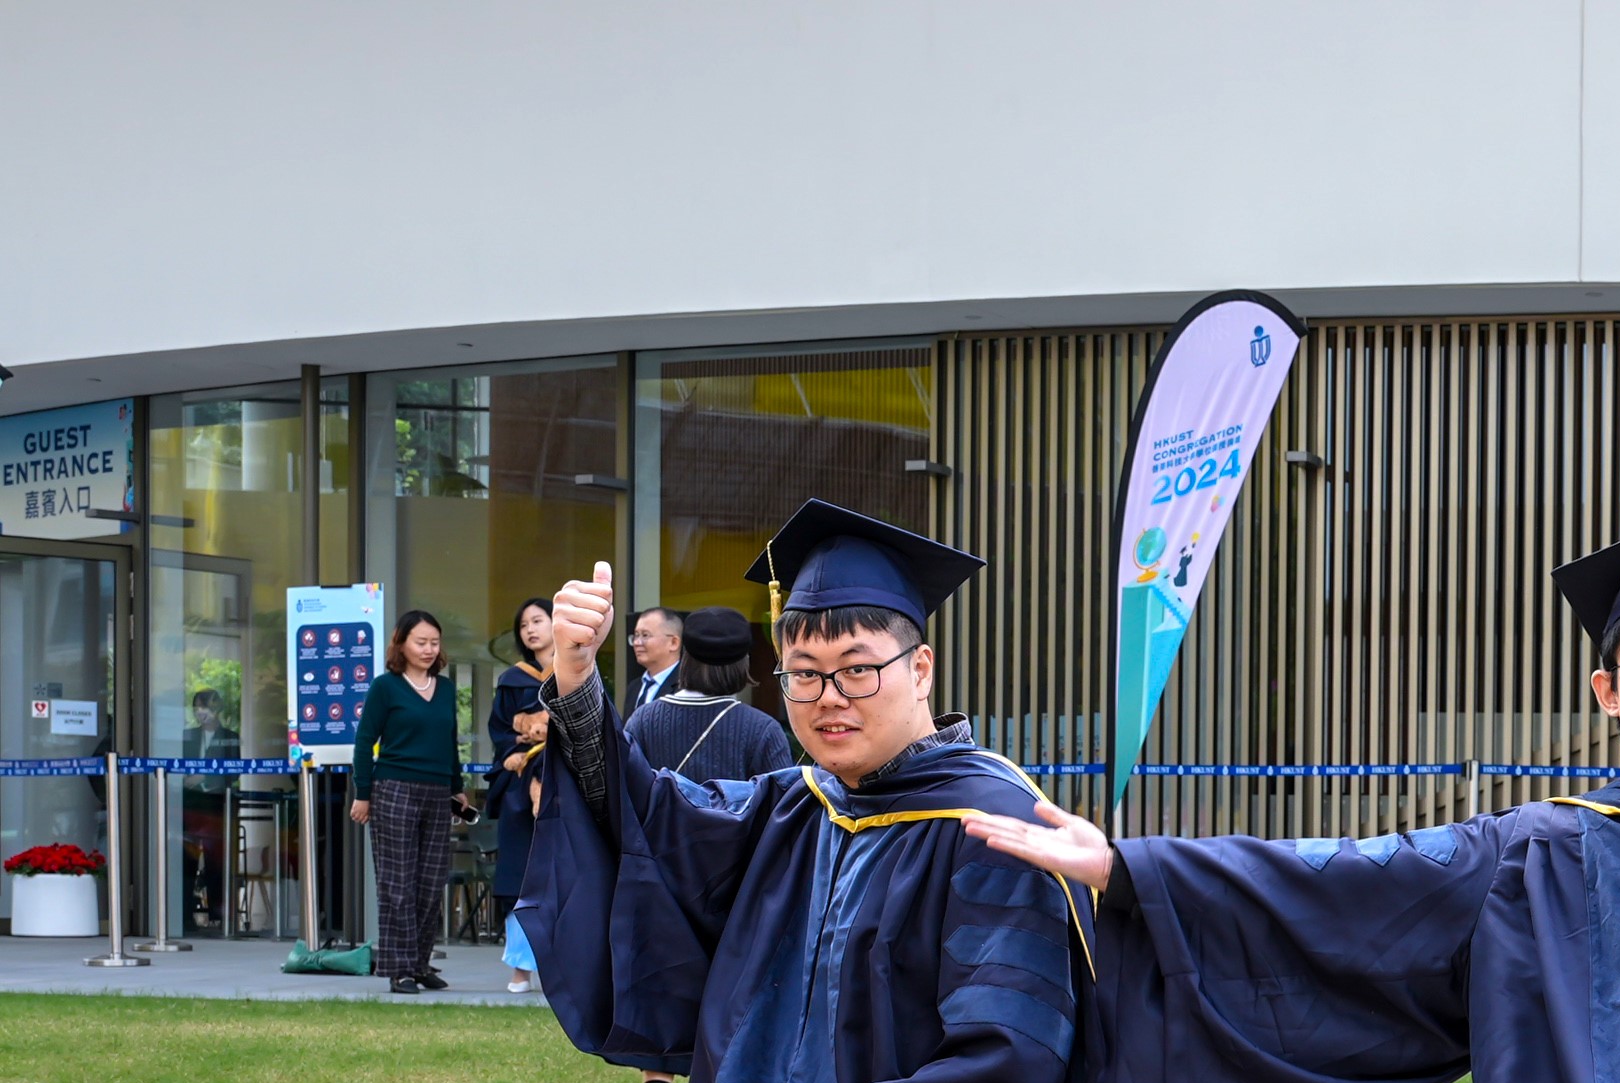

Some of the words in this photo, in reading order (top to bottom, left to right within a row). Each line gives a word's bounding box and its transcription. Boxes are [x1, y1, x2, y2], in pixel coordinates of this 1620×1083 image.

[24, 424, 91, 454] GUEST
[1153, 430, 1194, 449] HKUST
[3, 450, 113, 486] ENTRANCE
[1151, 448, 1241, 506] 2024
[25, 486, 90, 519] 嘉賓入口
[185, 760, 206, 768] HKUST
[224, 760, 245, 768] HKUST
[1483, 766, 1508, 774] HKUST
[1529, 767, 1554, 775] HKUST
[1576, 768, 1601, 776] HKUST
